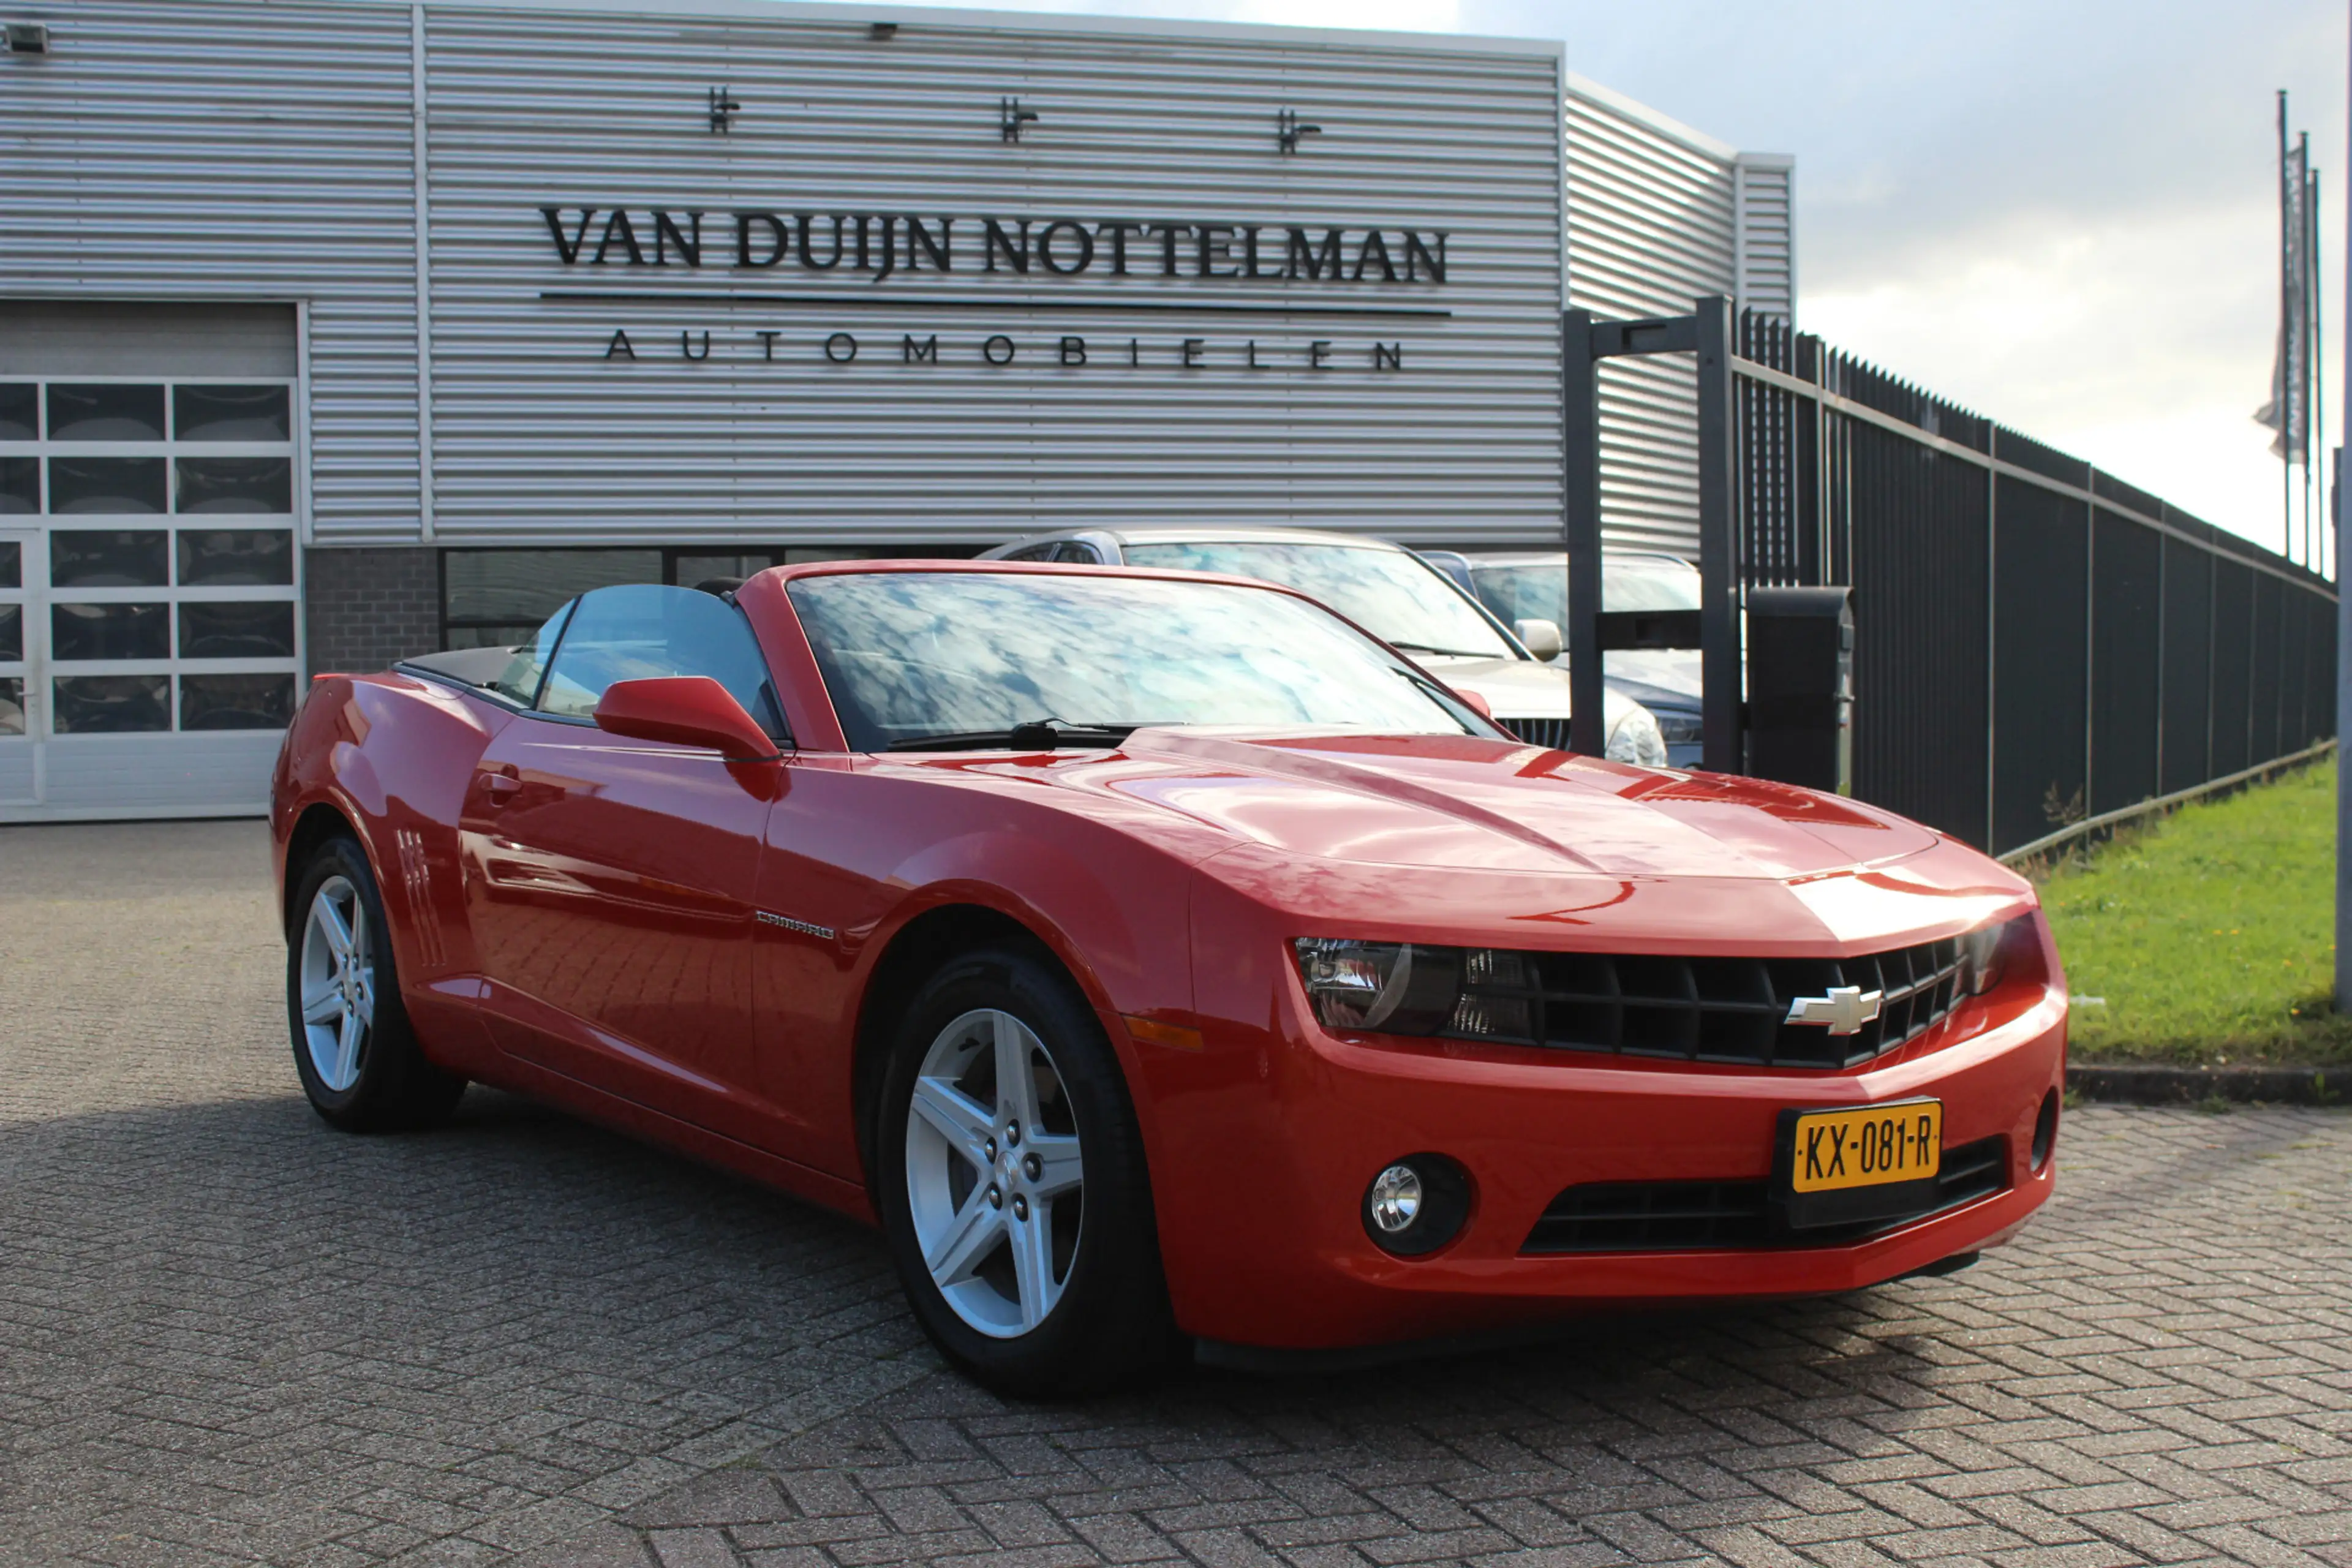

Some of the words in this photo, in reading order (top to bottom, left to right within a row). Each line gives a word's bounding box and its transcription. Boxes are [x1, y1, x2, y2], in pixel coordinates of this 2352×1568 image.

[539, 208, 704, 267] VAN
[733, 213, 957, 283] DUIJN
[981, 219, 1450, 284] NOTTELMAN
[605, 328, 1402, 371] AUTOMOBIELEN
[1805, 1114, 1931, 1180] KX-081-R
